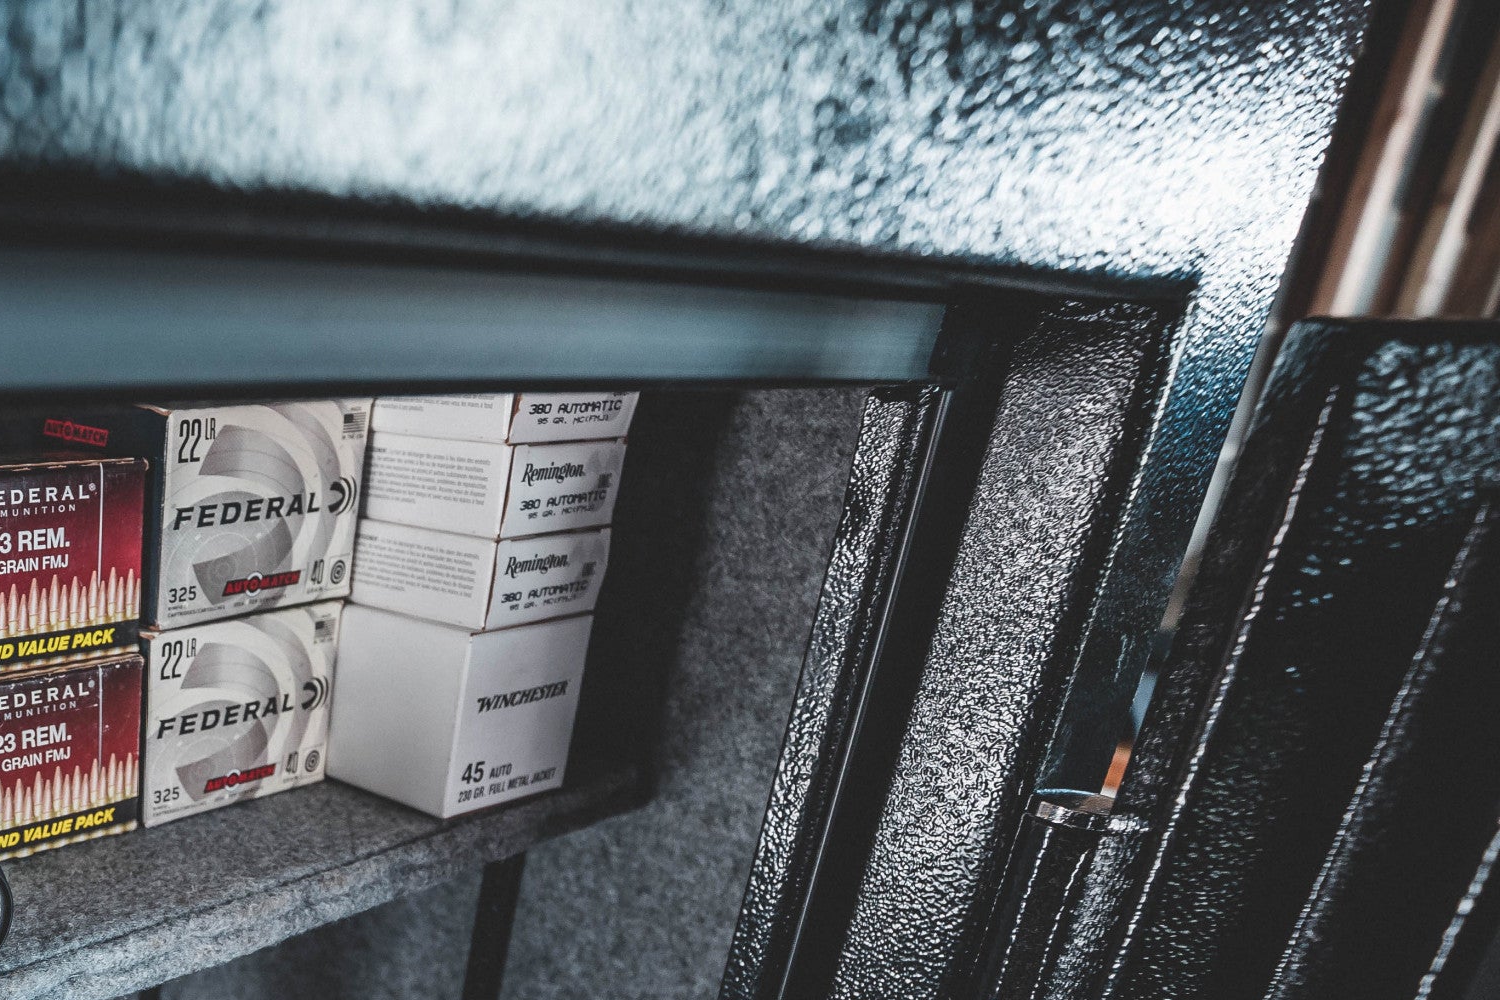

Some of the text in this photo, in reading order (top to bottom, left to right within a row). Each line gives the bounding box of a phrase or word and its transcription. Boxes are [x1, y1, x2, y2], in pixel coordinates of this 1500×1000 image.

[529, 400, 622, 415] 380 AUTOMATIC
[177, 417, 216, 464] 22 LR
[521, 462, 585, 487] Remington
[173, 492, 321, 531] FEDERAL
[520, 490, 607, 511] 380 AUTOMATIC
[18, 526, 71, 552] REM.
[42, 554, 69, 570] FMJ
[505, 554, 568, 579] Remington
[168, 586, 197, 604] 325
[501, 580, 589, 604] 380 AUTOMATIC
[17, 635, 71, 657] VALUE
[72, 628, 116, 650] PACK
[160, 638, 197, 680] 22 LR
[477, 680, 568, 714] WINCHESTER
[157, 694, 294, 740] FEDERAL
[21, 722, 72, 750] REM.
[1, 752, 43, 772] GRAIN
[46, 746, 71, 762] FMJ
[462, 760, 513, 784] 45 AUTO
[153, 786, 180, 804] 325
[23, 818, 74, 843] VALUE
[74, 808, 116, 831] PACK
